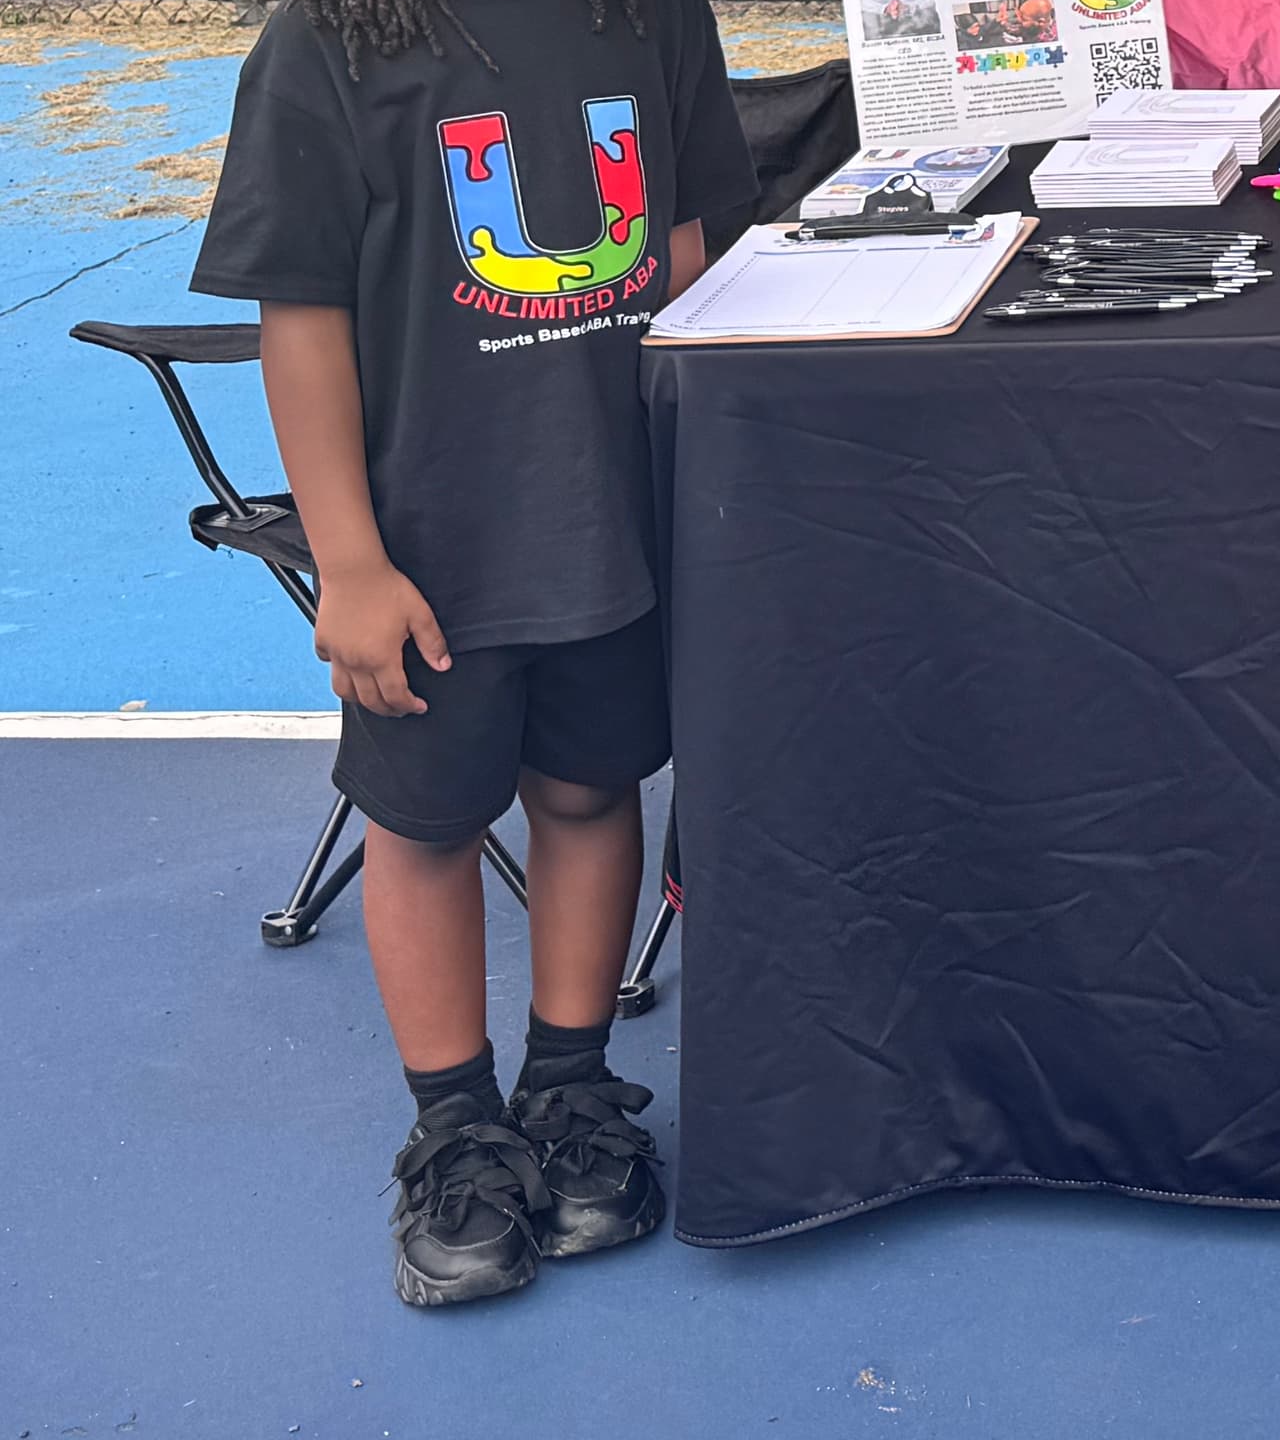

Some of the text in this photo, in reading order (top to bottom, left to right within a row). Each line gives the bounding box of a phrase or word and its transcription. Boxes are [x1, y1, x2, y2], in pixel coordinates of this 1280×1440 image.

[1071, 2, 1127, 20] UNLIMITED
[453, 281, 615, 320] UNLIMITED
[622, 255, 659, 300] ABA
[478, 334, 534, 353] Sports
[538, 321, 587, 342] Based
[586, 316, 612, 332] ABA
